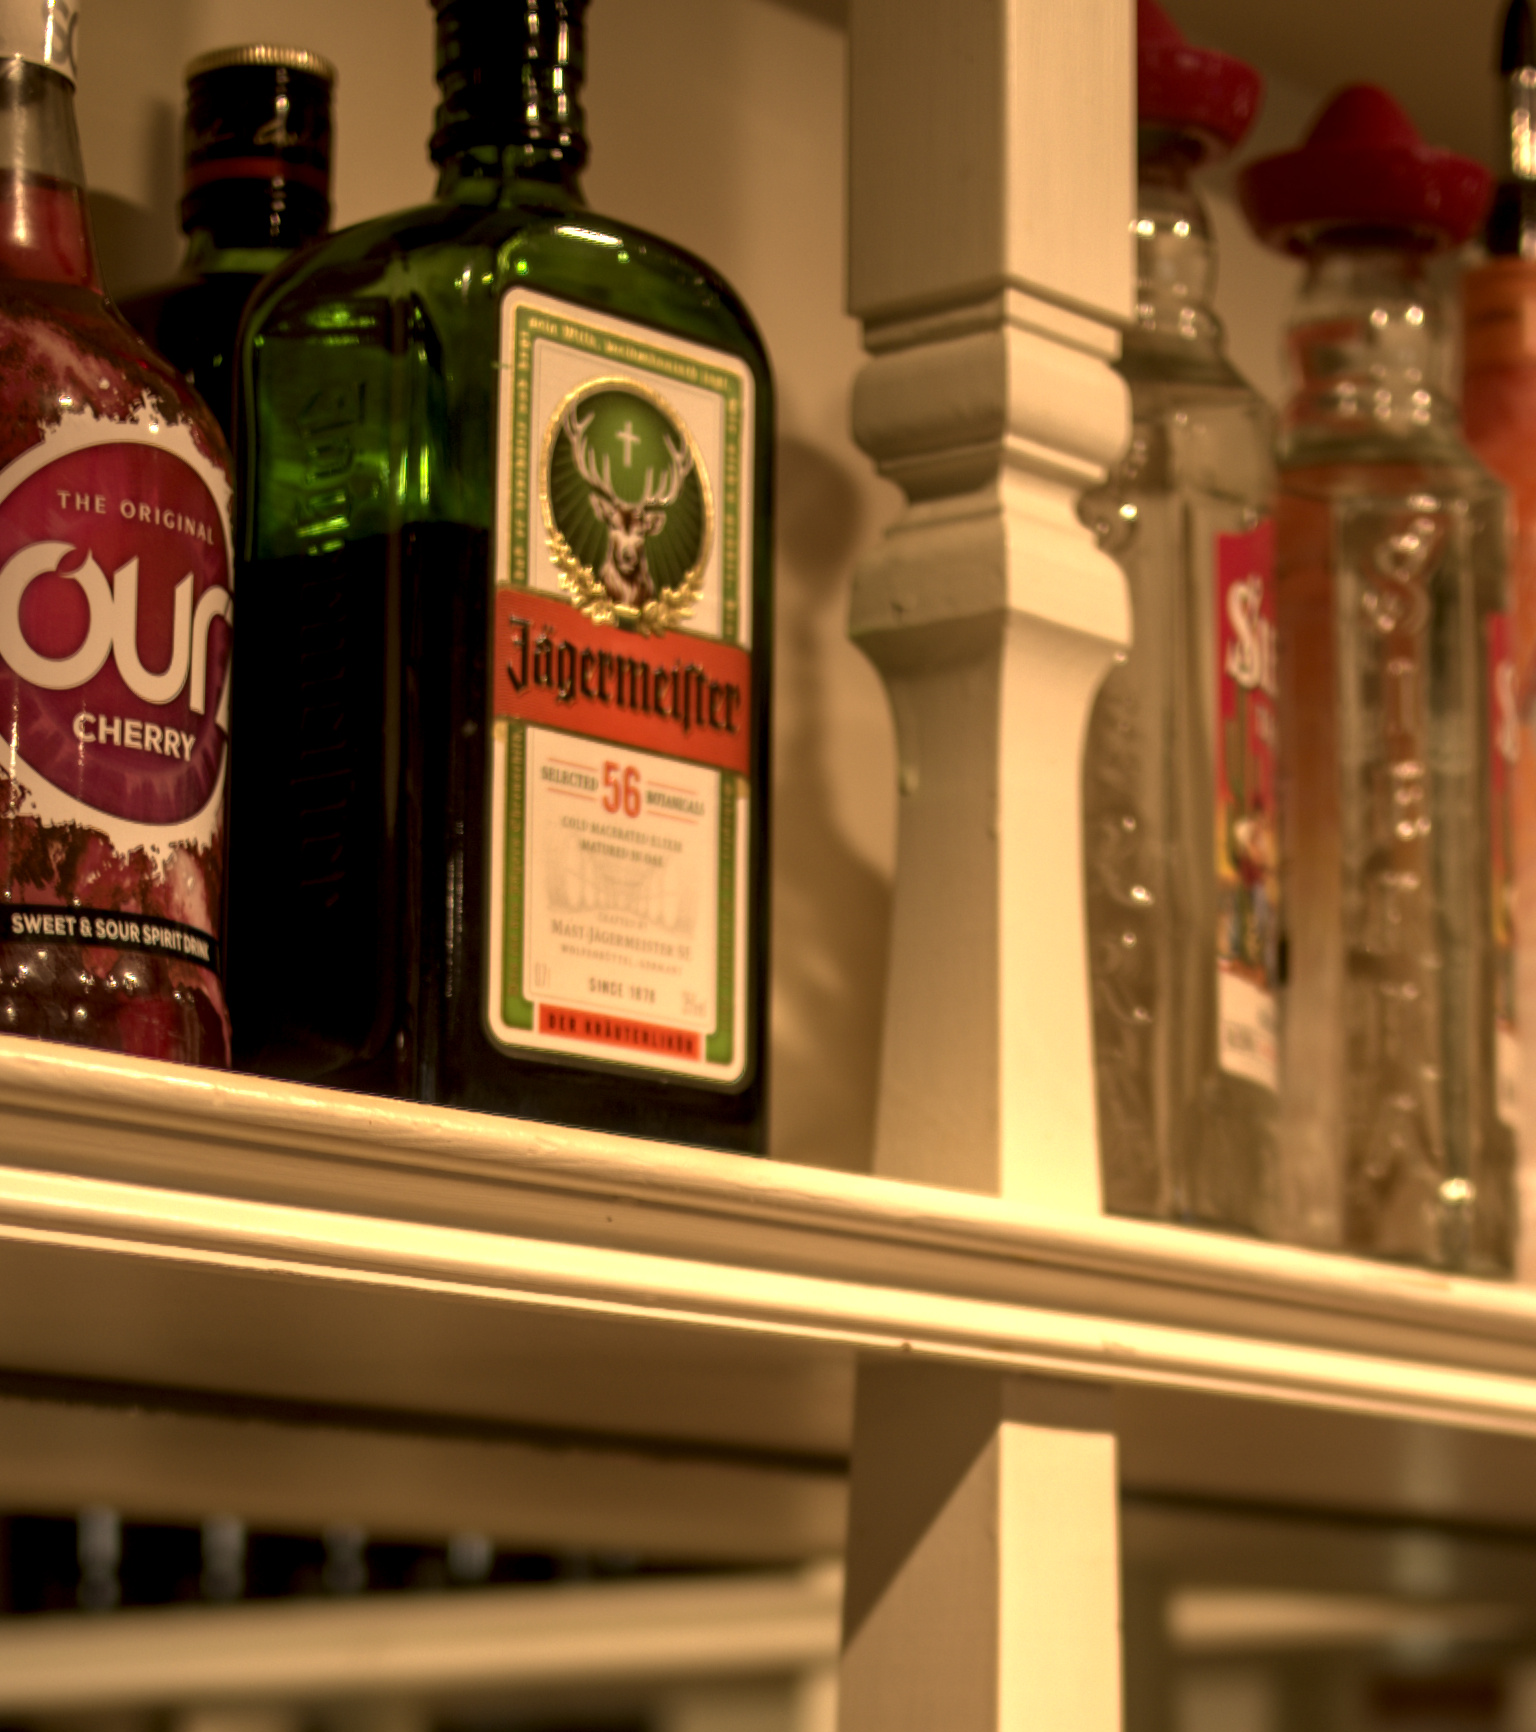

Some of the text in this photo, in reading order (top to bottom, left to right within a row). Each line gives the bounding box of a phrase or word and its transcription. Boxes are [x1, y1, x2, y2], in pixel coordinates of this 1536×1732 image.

[56, 489, 216, 548] THE ORIGINAL
[73, 711, 196, 763] CHERRY
[541, 764, 598, 793] SELECTED
[601, 759, 642, 819] 56
[11, 911, 210, 962] SWEET & SOUR SPIRIT DRINK
[588, 976, 625, 1000] SINCE
[548, 1011, 578, 1034] DER
